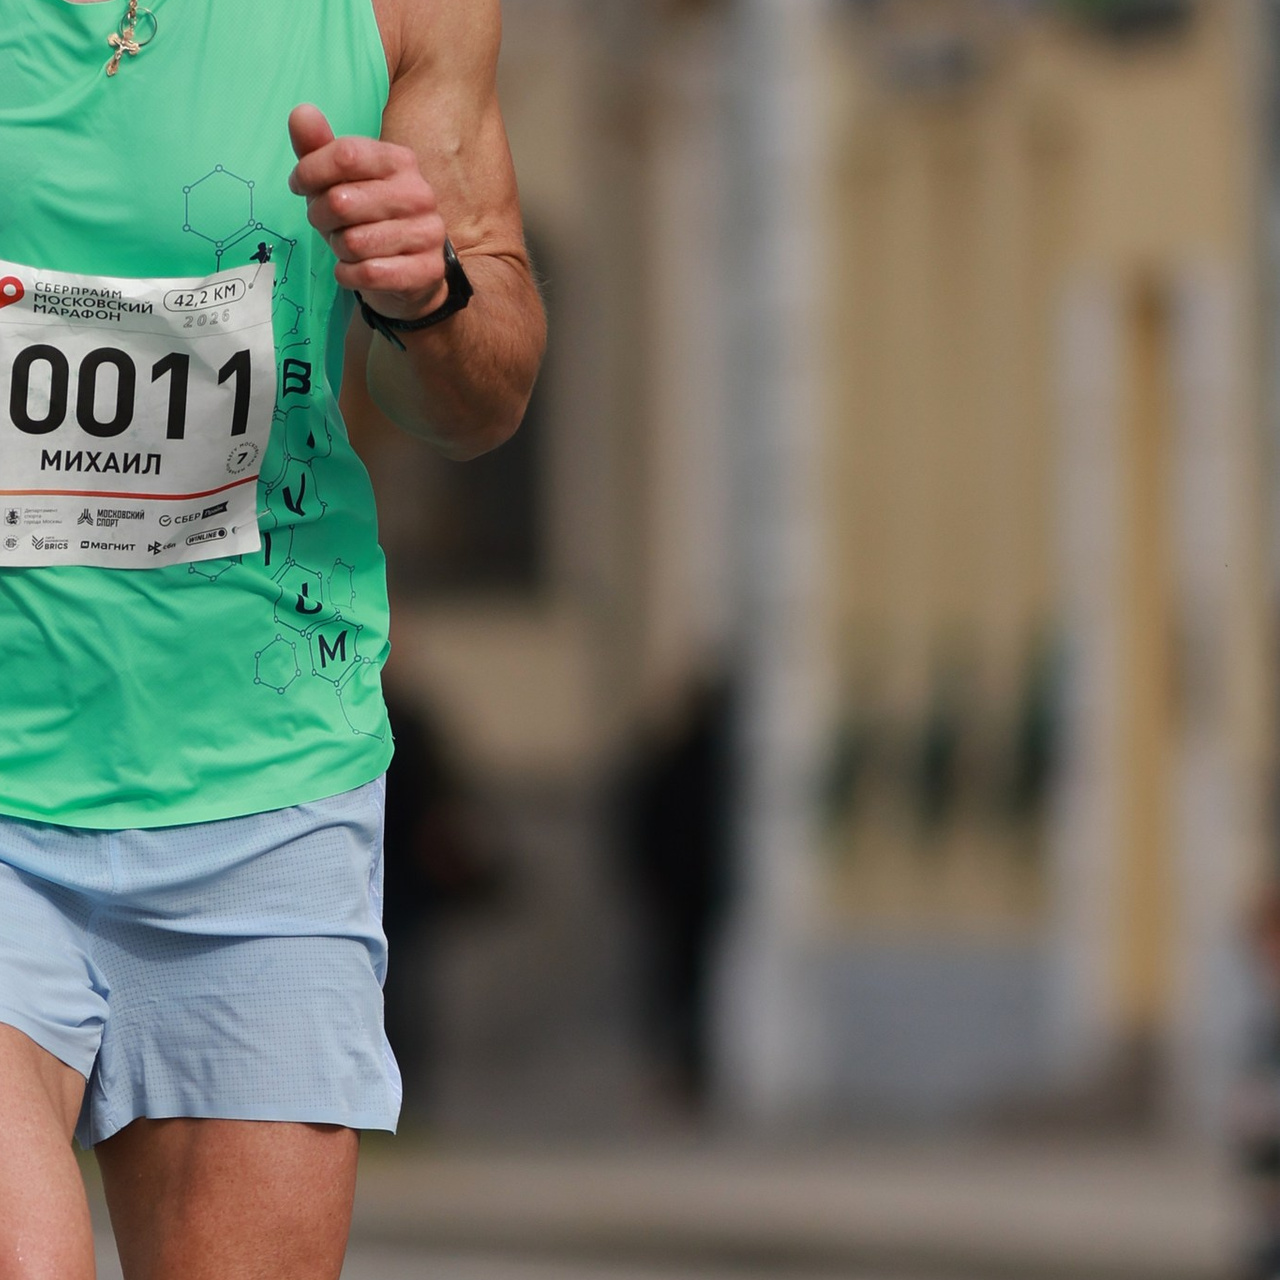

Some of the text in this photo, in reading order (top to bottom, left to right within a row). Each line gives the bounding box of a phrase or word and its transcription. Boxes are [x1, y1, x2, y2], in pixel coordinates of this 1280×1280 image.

[35, 281, 122, 299] СБЕРПРАЙМ
[34, 293, 153, 314] МОСКОВСКИЙ
[174, 290, 208, 308] 42,2
[33, 304, 121, 322] МАРАФОН
[40, 449, 162, 475] МИХАИЛ
[237, 451, 249, 465] 7
[96, 509, 145, 520] МОСКОВСКИЙ
[174, 512, 201, 524] СБЕР
[96, 518, 120, 527] СПОРТ
[188, 531, 218, 543] WINLINE
[91, 542, 136, 551] магнит
